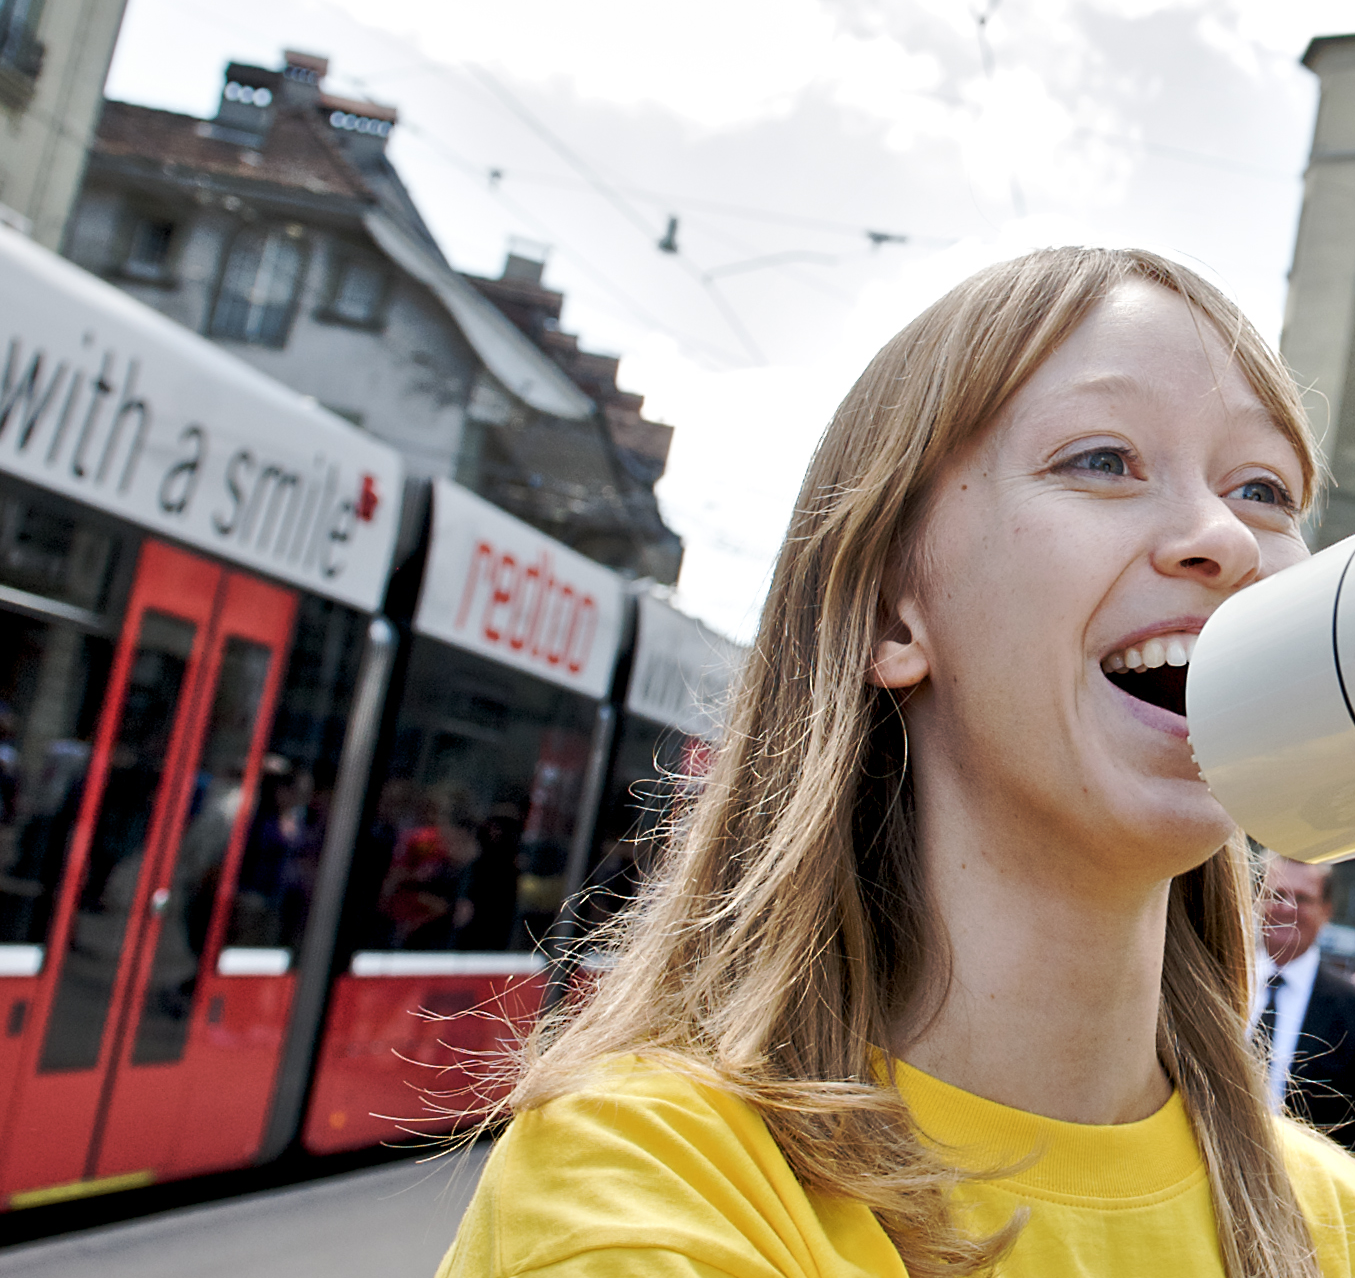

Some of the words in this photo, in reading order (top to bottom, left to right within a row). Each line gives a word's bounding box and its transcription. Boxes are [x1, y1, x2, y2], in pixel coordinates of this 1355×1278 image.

[0, 329, 152, 499] with
[158, 421, 206, 515] a
[211, 447, 362, 583] smile
